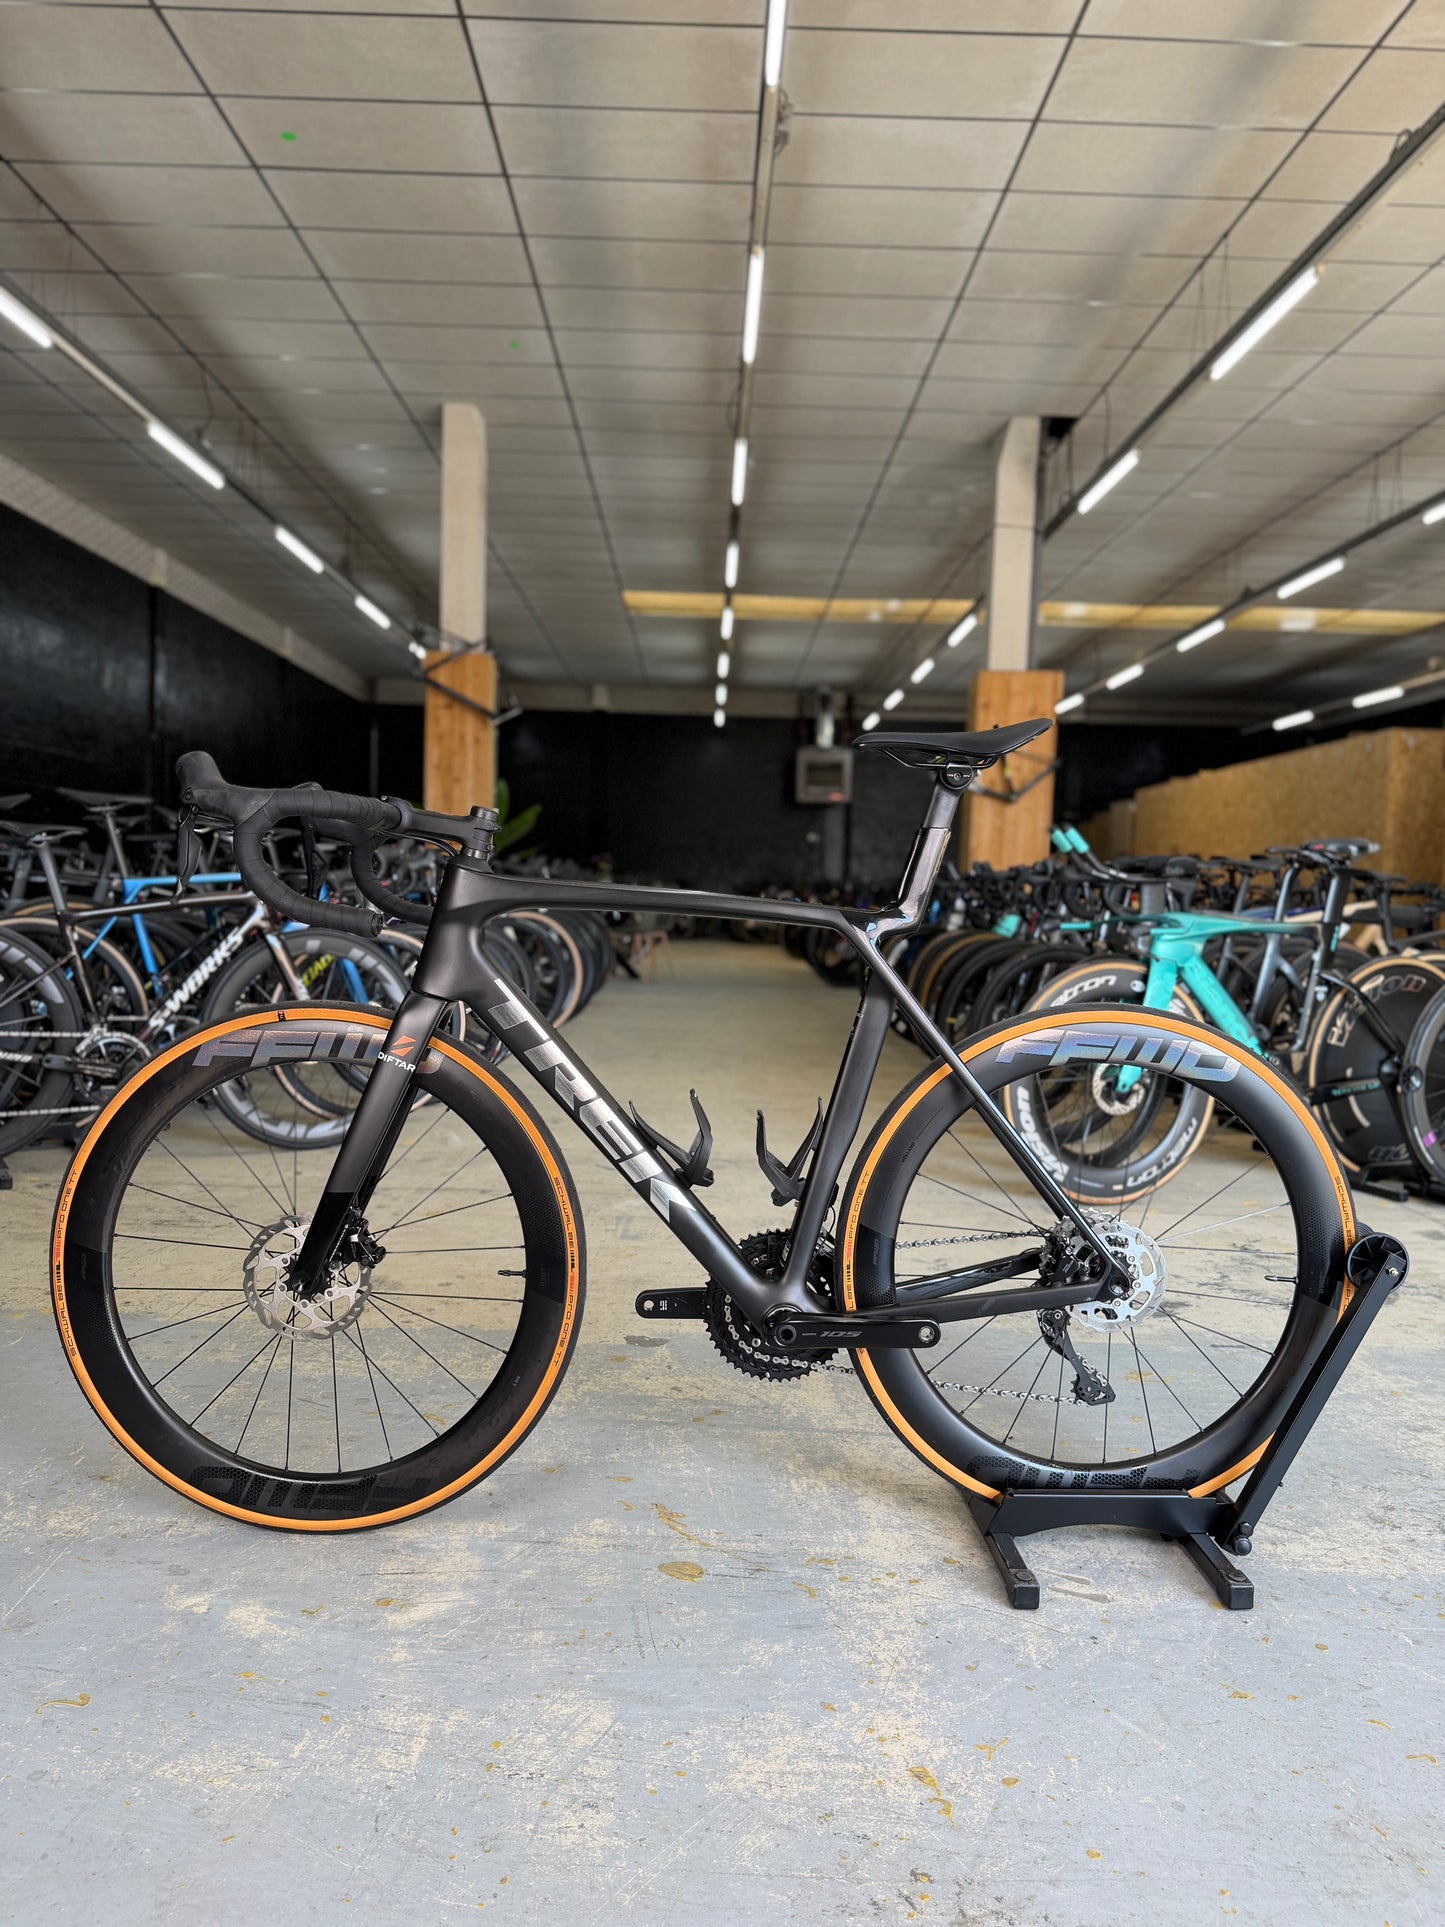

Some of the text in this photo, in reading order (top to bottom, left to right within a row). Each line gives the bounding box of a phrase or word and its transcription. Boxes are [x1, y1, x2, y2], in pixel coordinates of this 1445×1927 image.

[149, 926, 243, 1033] S-WORKS
[1050, 974, 1117, 1007] etron
[377, 1051, 416, 1073] DIFTAR
[995, 1028, 1241, 1082] FFWD
[488, 978, 697, 1223] TREK
[553, 1176, 575, 1249] SCHWALBE
[56, 1284, 77, 1357] SCHWALBE
[819, 1330, 863, 1338] 105
